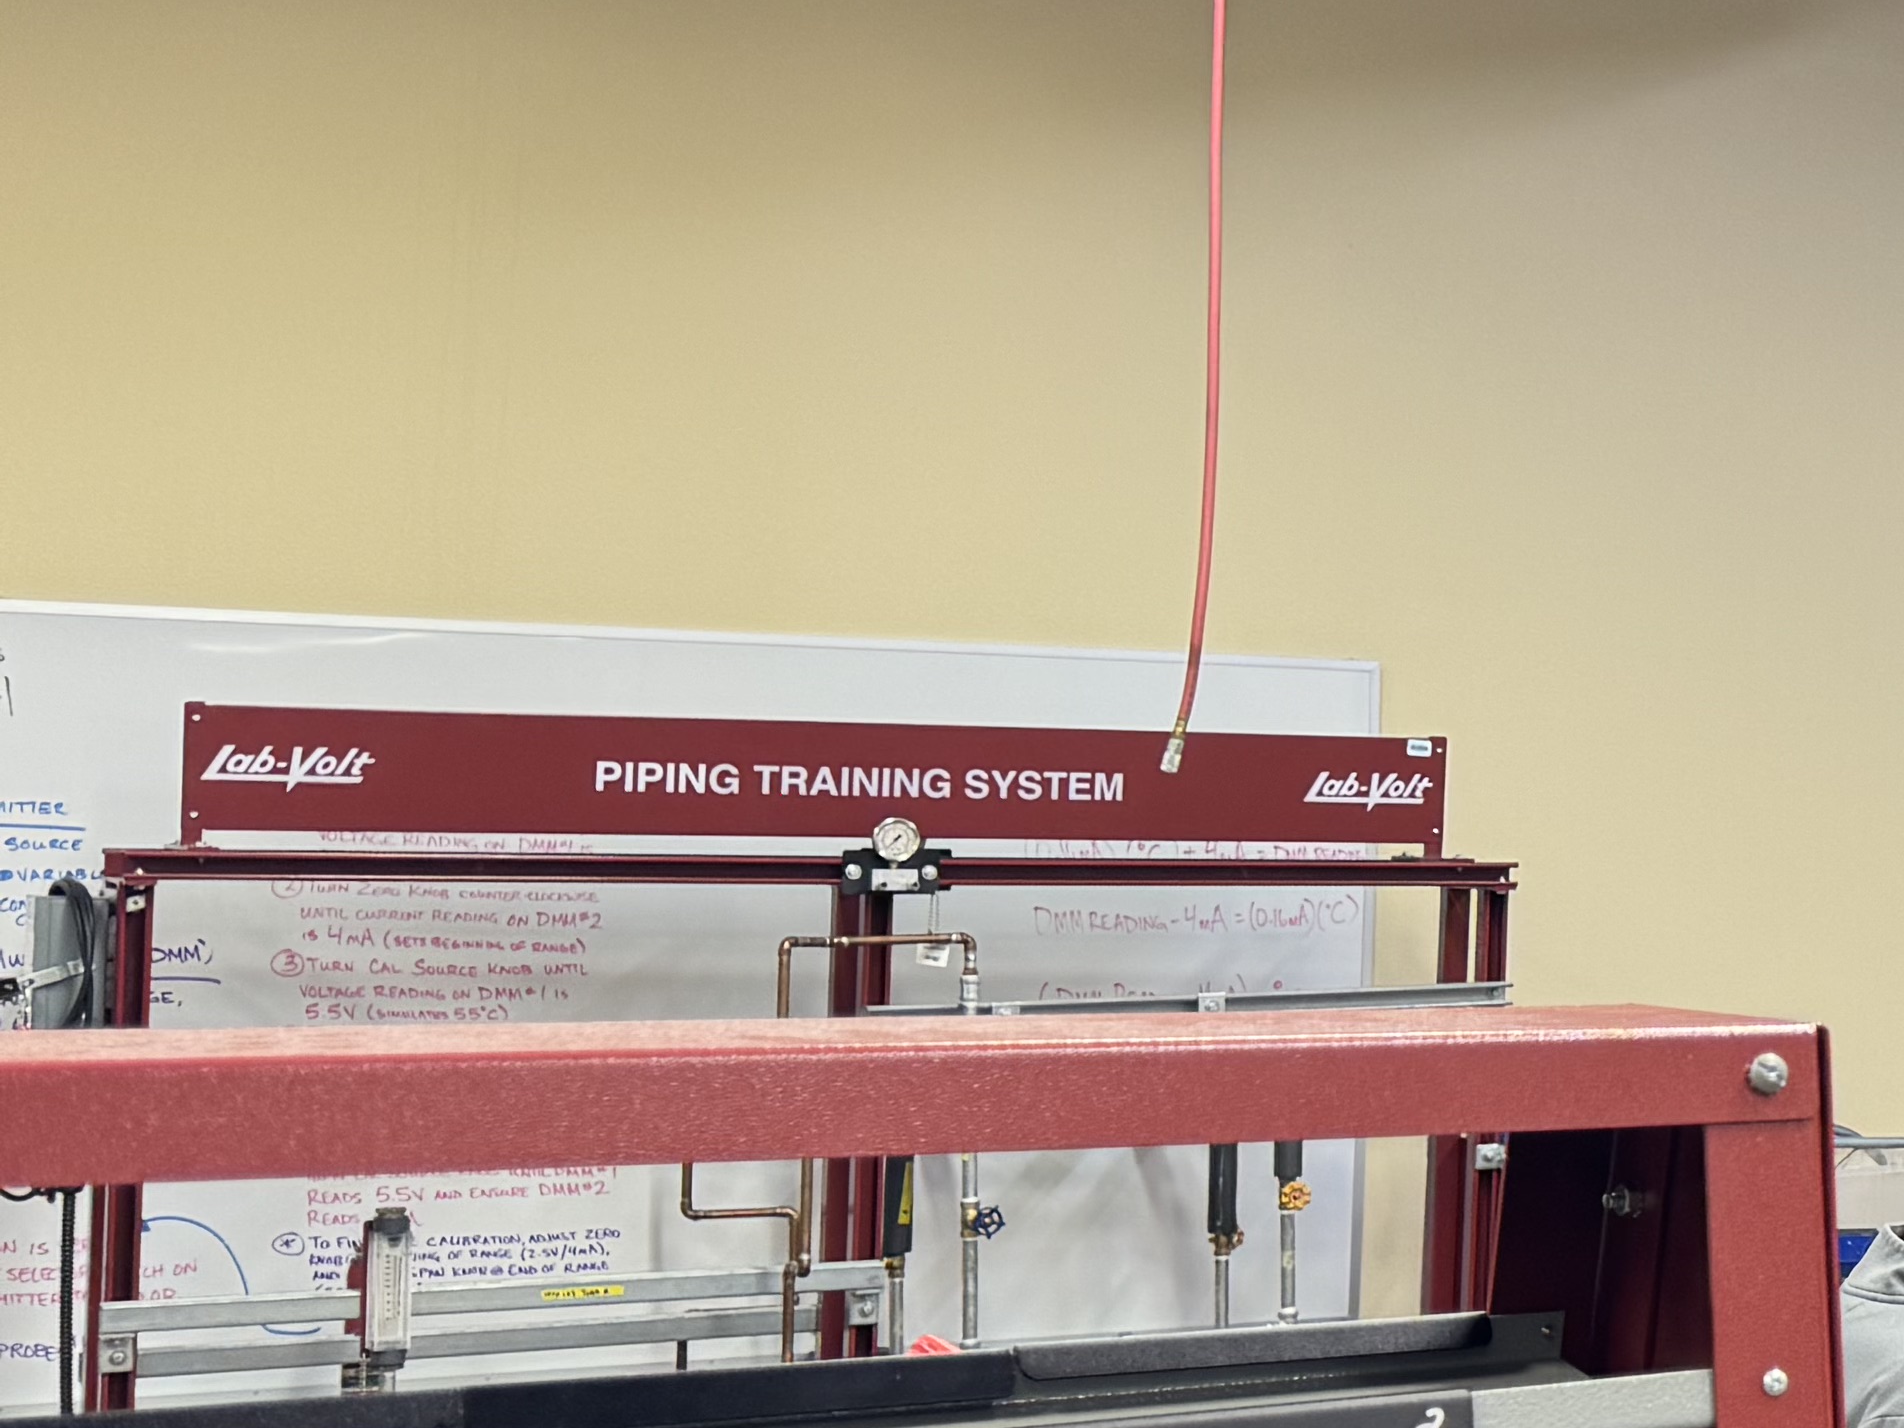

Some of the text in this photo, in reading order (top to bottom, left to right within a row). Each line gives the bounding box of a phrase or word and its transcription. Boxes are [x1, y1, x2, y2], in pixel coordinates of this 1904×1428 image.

[201, 744, 376, 792] Lab-Volt
[595, 760, 1124, 802] PIPING TRAINING SYSTEM
[1304, 770, 1432, 810] Lab-Volt
[5, 837, 83, 851] SOURCE
[301, 907, 348, 920] UNTIL
[432, 911, 498, 925] READING
[507, 913, 529, 927] ON
[306, 957, 354, 972] TURN
[369, 958, 400, 974] CAL
[414, 959, 478, 977] SOURCE
[488, 963, 533, 976] KNOB
[544, 963, 589, 976] UNTIL
[299, 984, 366, 999] VOLTAGE
[374, 986, 446, 1001] READING
[452, 989, 471, 1000] ON
[307, 1189, 362, 1205] READS
[434, 1190, 462, 1201] AND
[585, 1228, 621, 1240] ZERO
